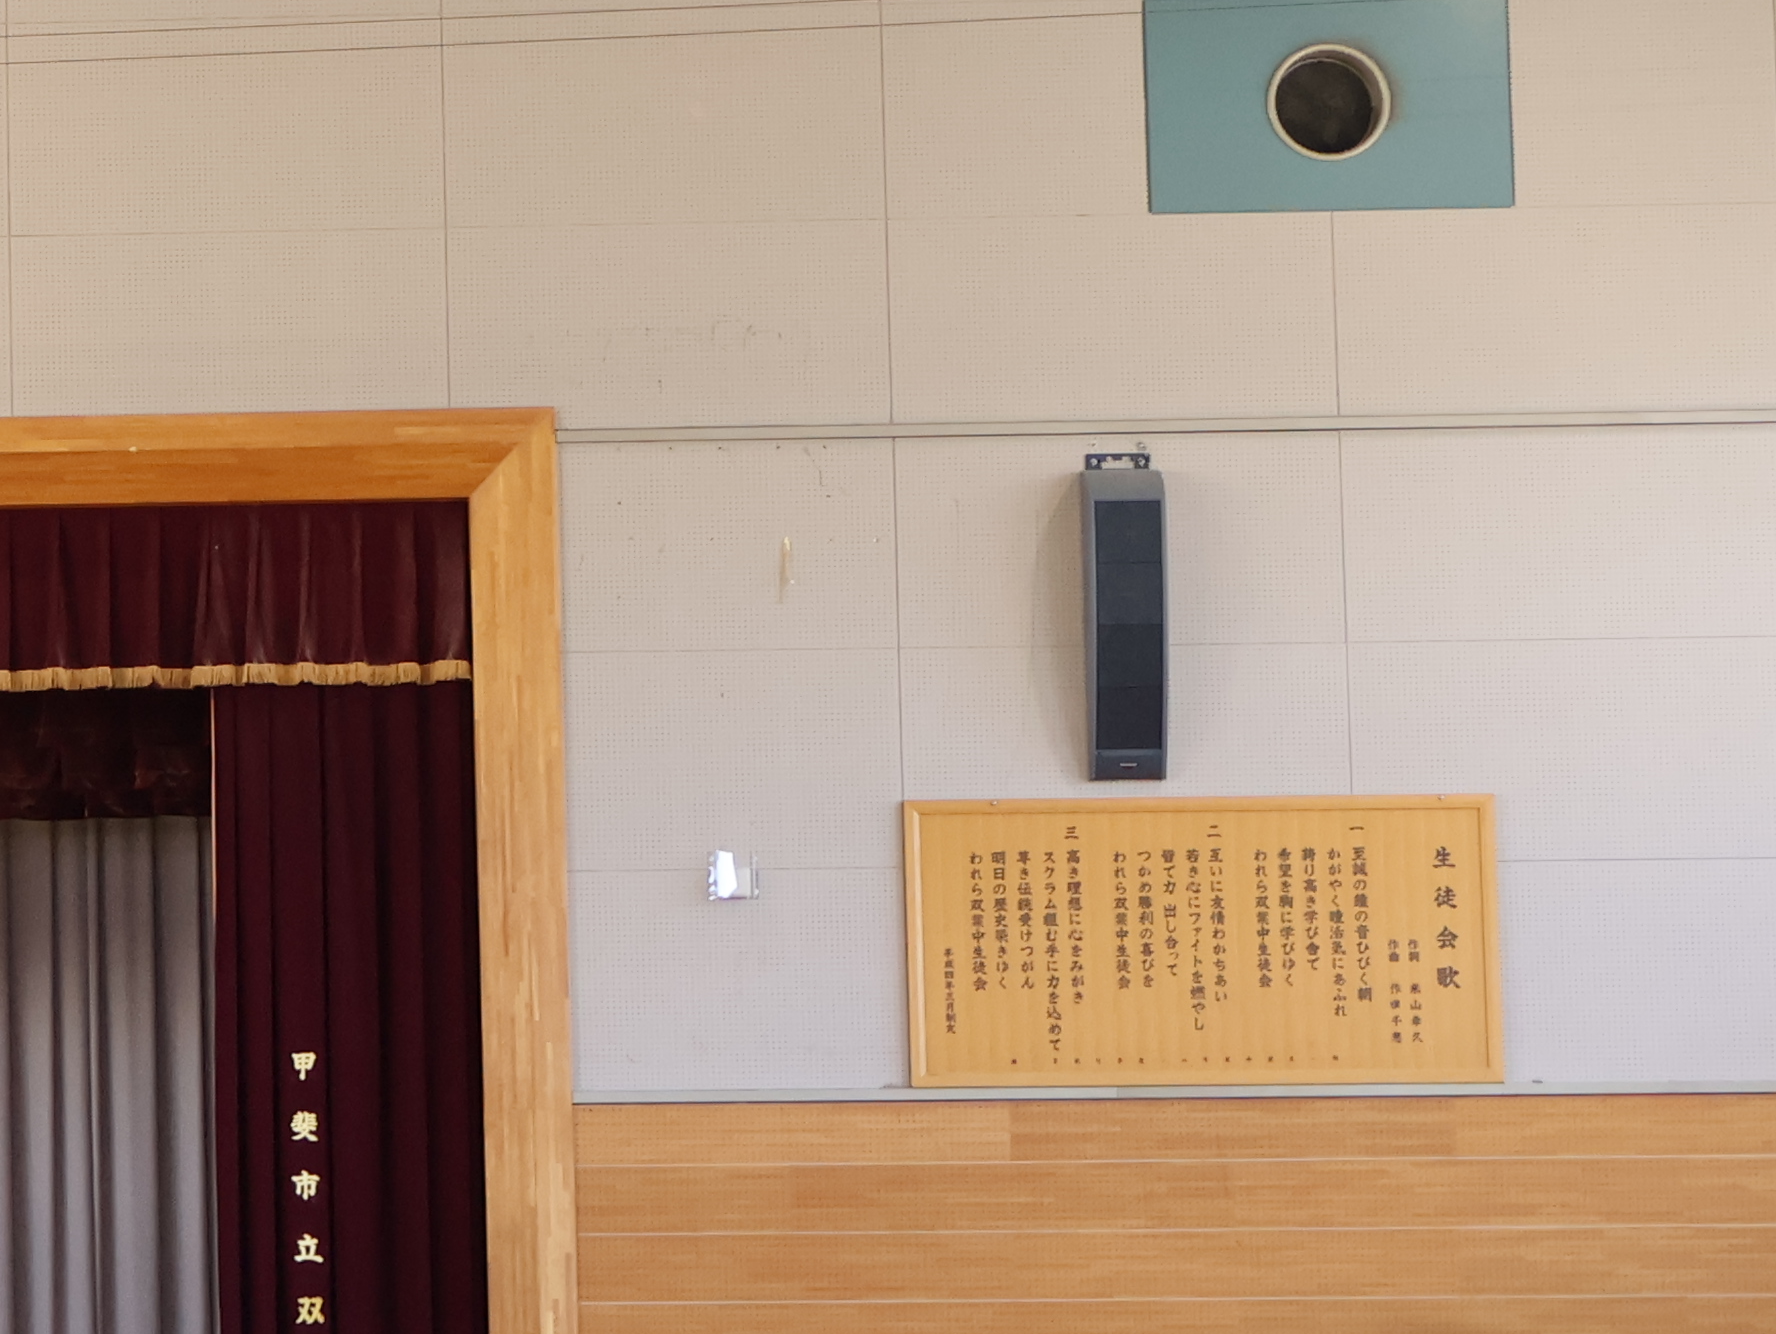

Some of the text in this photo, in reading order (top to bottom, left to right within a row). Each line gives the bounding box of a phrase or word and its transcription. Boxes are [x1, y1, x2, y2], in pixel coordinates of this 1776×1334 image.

[1064, 825, 1080, 840] 三
[1206, 824, 1222, 839] 二
[969, 851, 989, 992] われら双葉中生徒会
[1113, 850, 1132, 990] われら双葉中生徒会
[1253, 849, 1273, 988] われら双葉中生徒会
[1432, 845, 1462, 990] 生徒会歌
